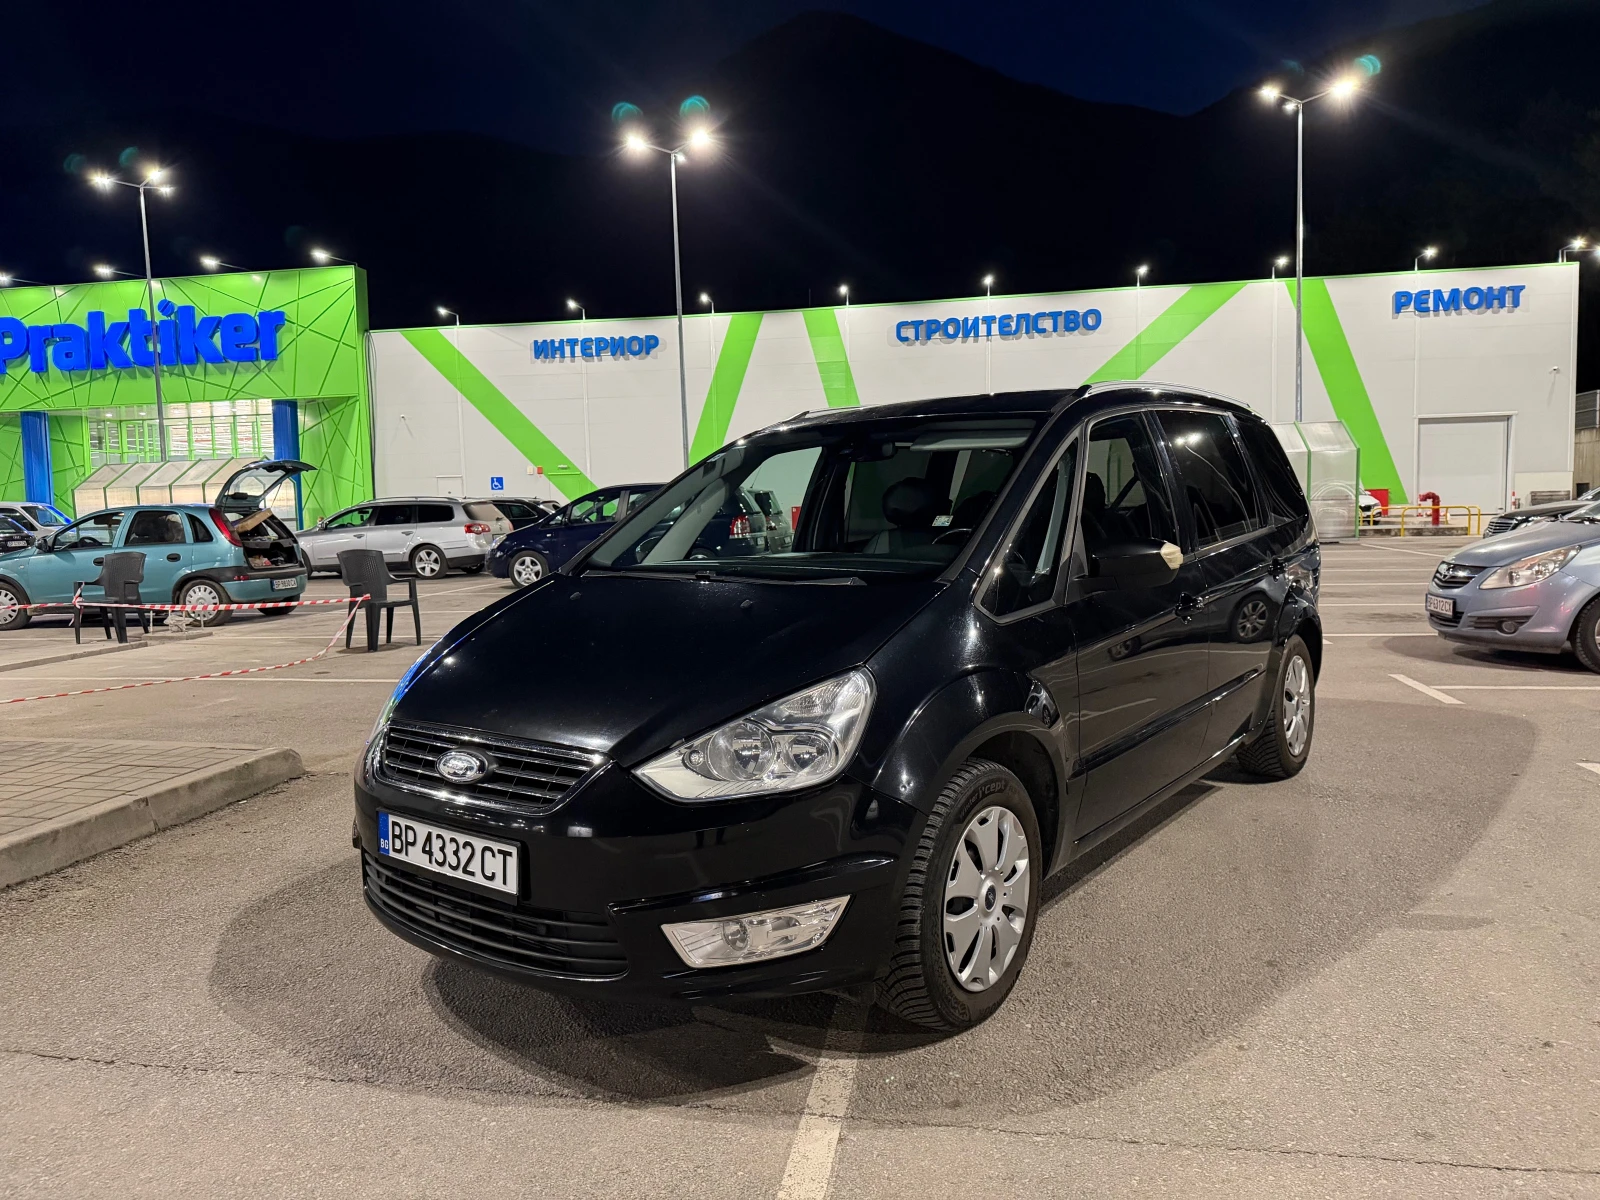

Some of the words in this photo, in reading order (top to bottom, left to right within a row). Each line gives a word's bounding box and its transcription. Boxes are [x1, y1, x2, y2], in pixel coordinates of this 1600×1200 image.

[1395, 285, 1526, 314] РЕМОНТ
[0, 299, 285, 374] Praktiker
[895, 308, 1102, 341] СТРОИТЕЛСТВО
[533, 335, 659, 359] ИНТЕРИОР
[380, 838, 389, 849] BG
[391, 820, 417, 857] BP
[421, 831, 475, 877] 4332
[481, 845, 513, 885] CT
